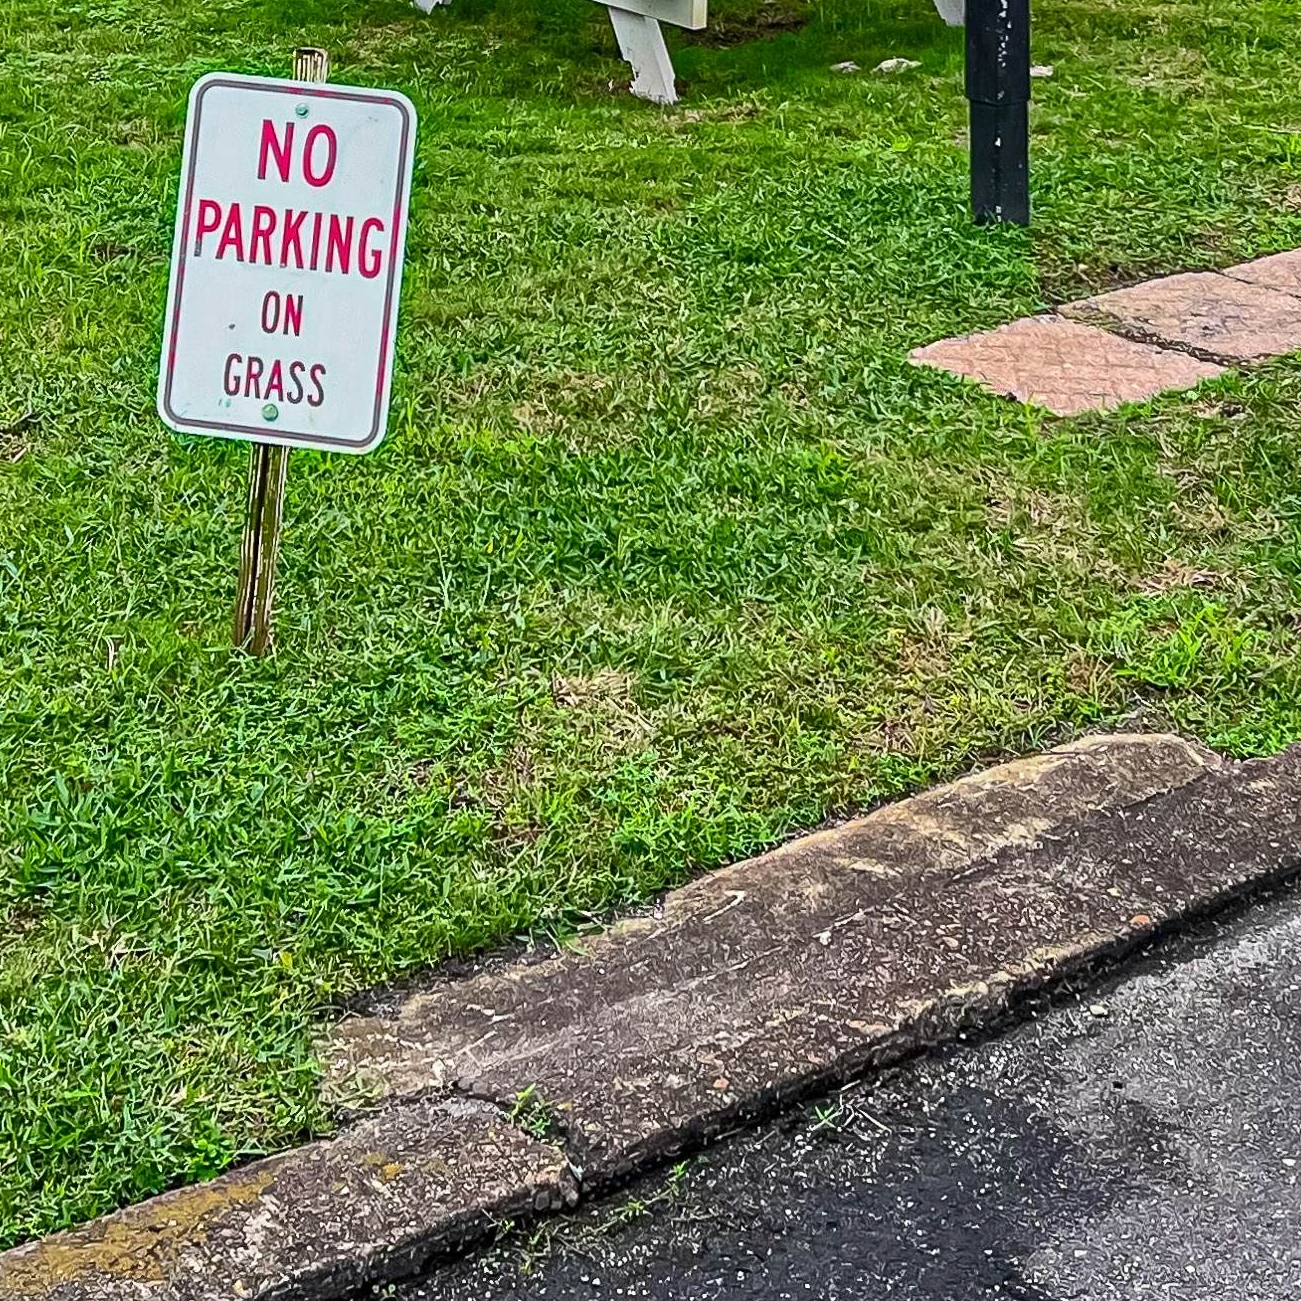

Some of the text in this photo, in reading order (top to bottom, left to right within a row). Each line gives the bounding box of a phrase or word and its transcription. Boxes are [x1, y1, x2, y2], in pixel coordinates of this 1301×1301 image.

[257, 118, 337, 188] NO
[193, 199, 385, 280] PARKING
[261, 290, 304, 337] ON
[223, 353, 327, 408] GRASS
